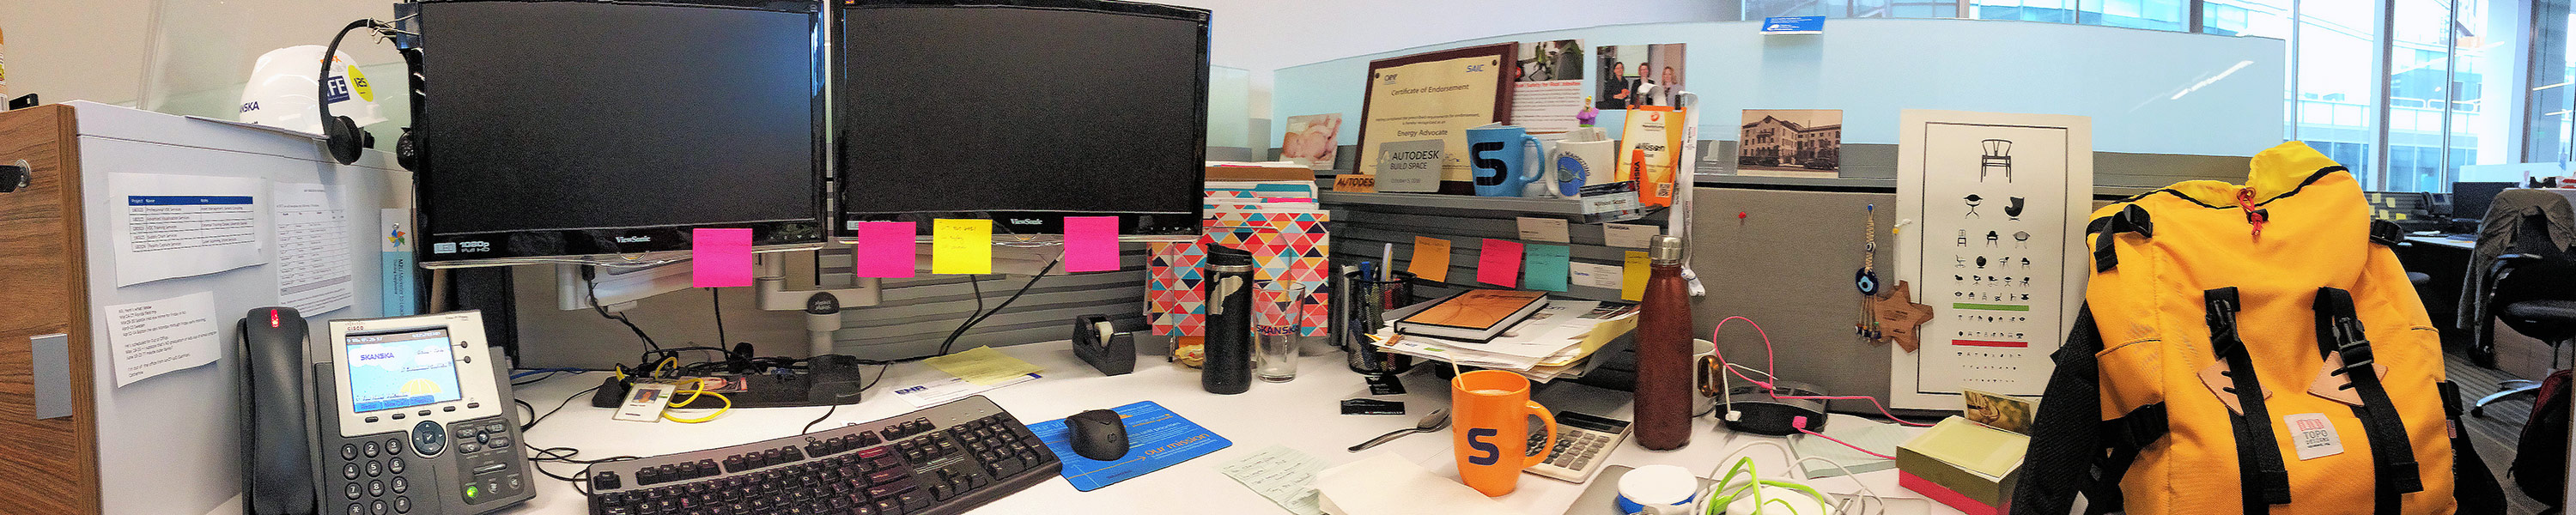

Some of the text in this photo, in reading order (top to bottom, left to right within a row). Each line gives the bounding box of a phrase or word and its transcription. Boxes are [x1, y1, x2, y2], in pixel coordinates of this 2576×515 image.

[1466, 64, 1485, 73] SAIC
[326, 78, 348, 97] FE
[1391, 88, 1419, 96] Certificate
[1428, 84, 1470, 94] Endorsement
[1391, 150, 1440, 161] AUTODESK
[1472, 141, 1508, 186] S
[1336, 178, 1376, 187] AUTODES
[616, 235, 651, 244] ViewSonic
[361, 352, 395, 361] SKANSKA
[895, 386, 928, 395] ENR
[2303, 430, 2328, 439] TOPO
[1145, 433, 1210, 456] our mission
[1467, 427, 1499, 466] S
